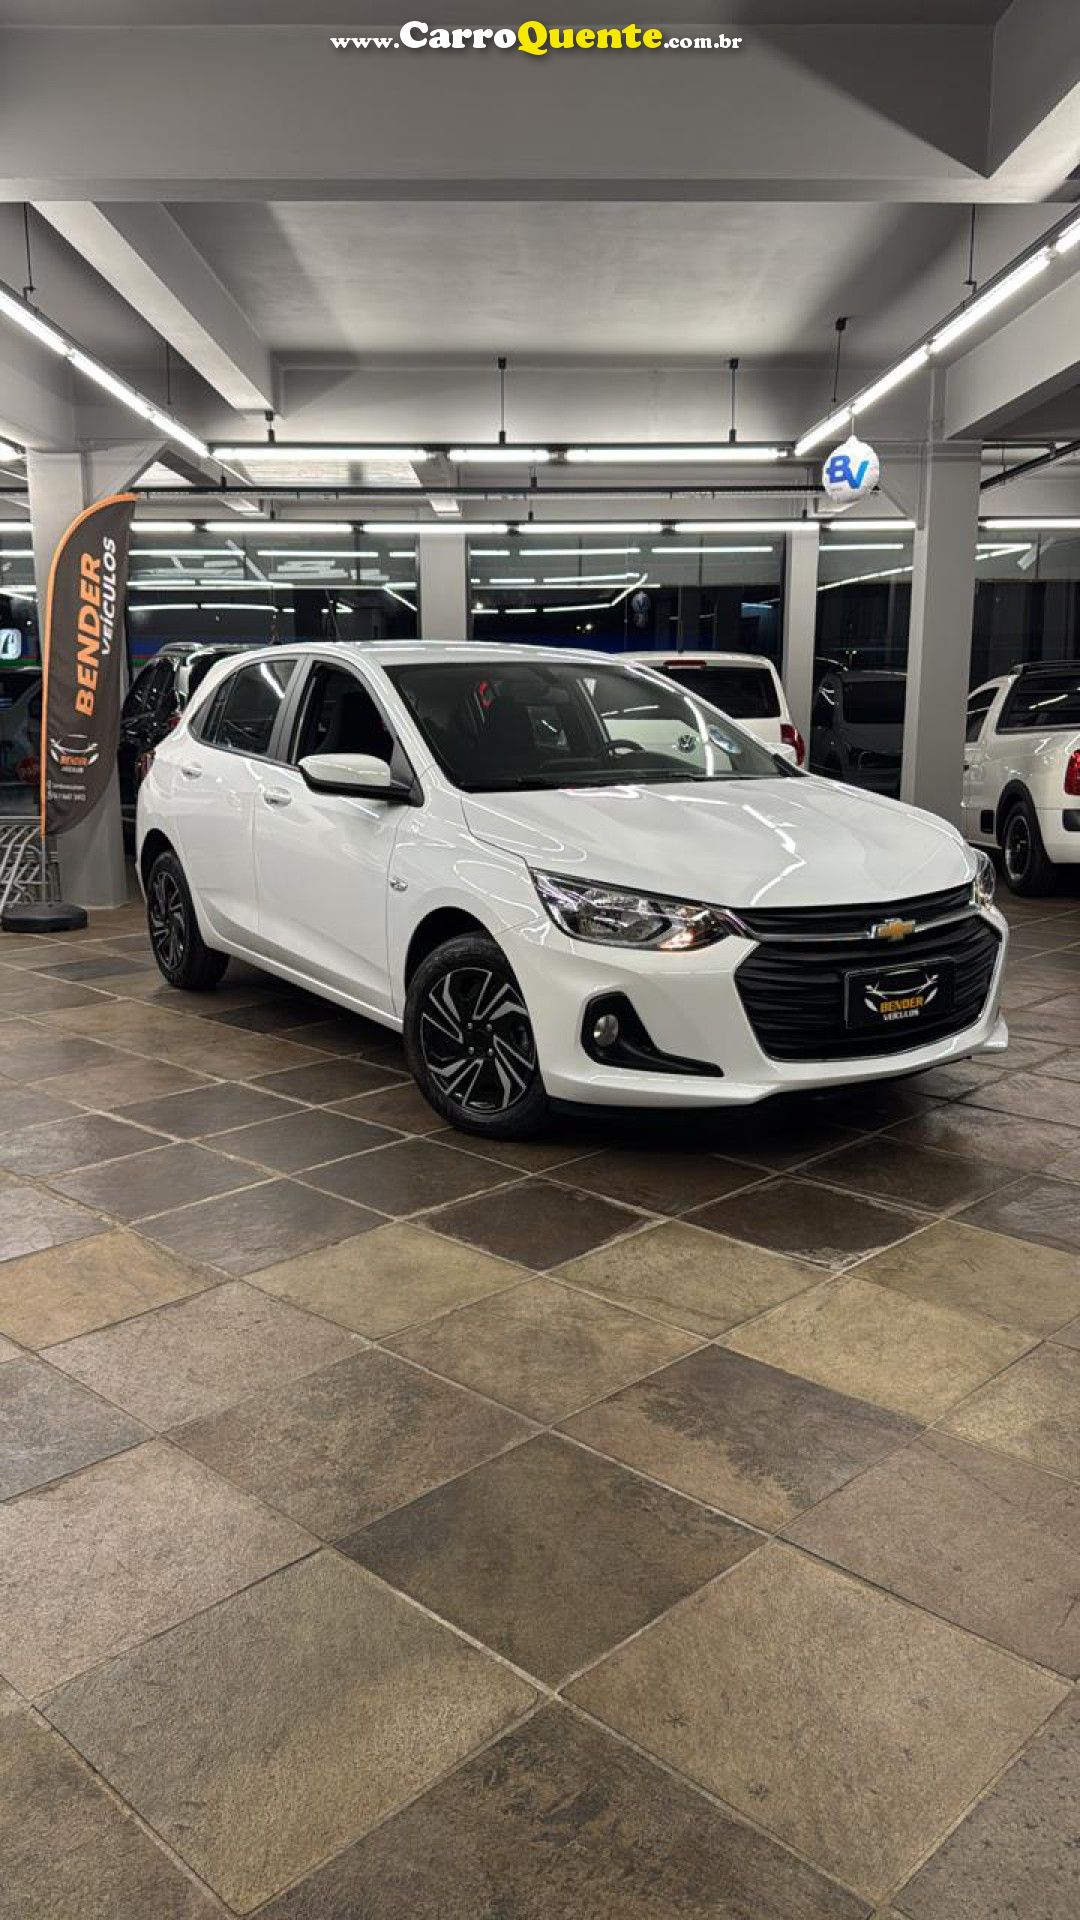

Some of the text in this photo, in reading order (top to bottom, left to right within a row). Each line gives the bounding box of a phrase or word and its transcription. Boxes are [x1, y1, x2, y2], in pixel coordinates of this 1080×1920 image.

[826, 455, 869, 489] BV
[75, 552, 101, 717] BENDER
[880, 995, 924, 1013] BENDER
